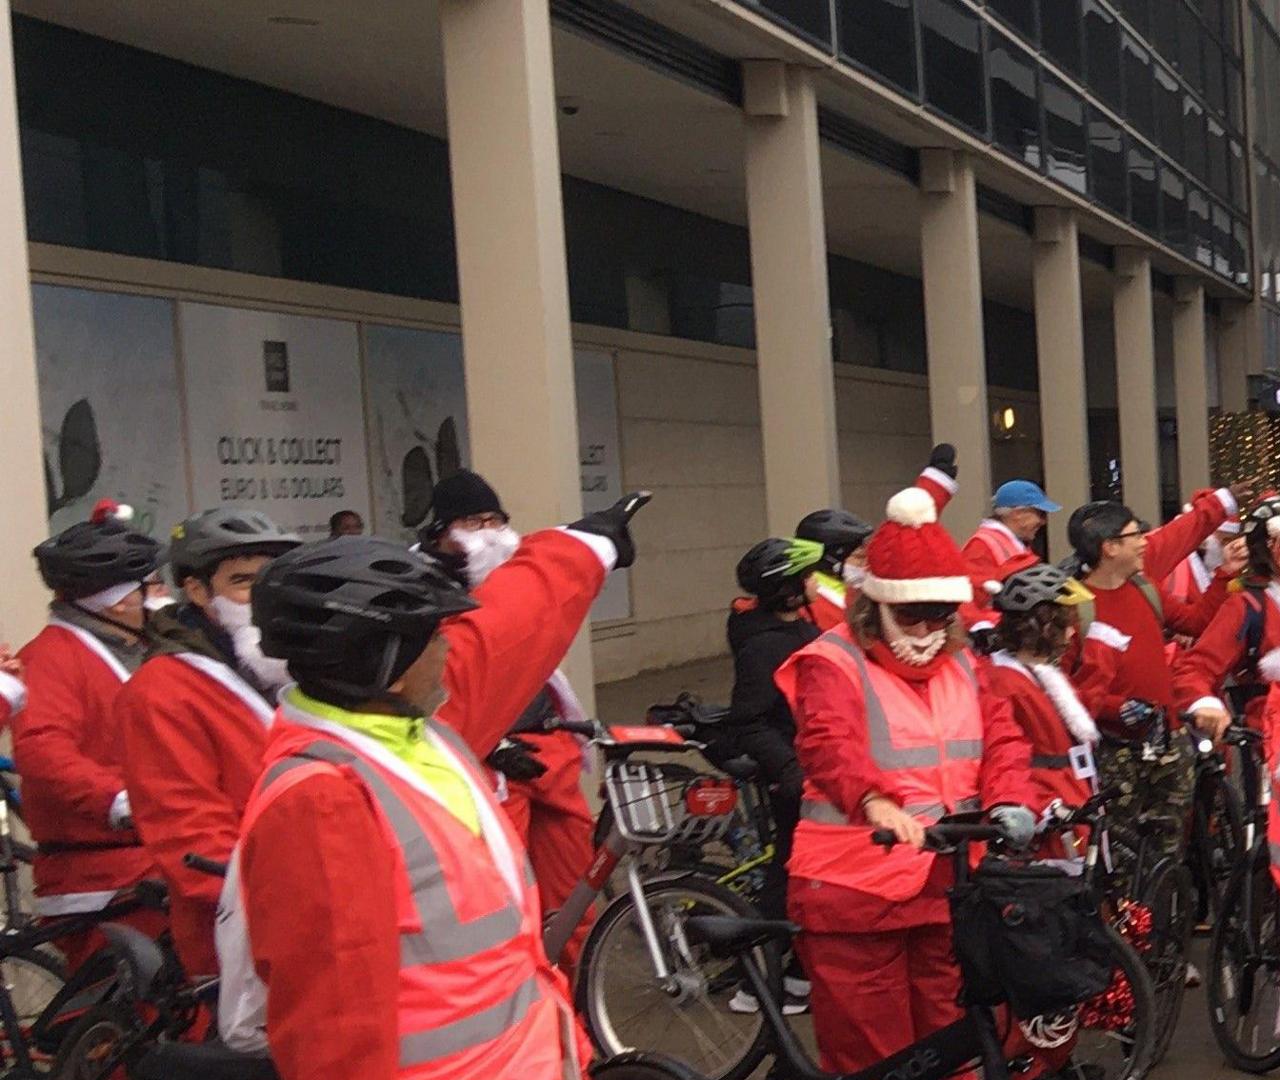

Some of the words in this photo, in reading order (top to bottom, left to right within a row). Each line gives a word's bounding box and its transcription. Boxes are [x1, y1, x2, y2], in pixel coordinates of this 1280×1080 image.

[217, 437, 262, 465] CLICK
[266, 438, 276, 465] &
[280, 437, 342, 465] COLLECT
[220, 477, 256, 500] EURO
[291, 476, 344, 498] DOLLARS
